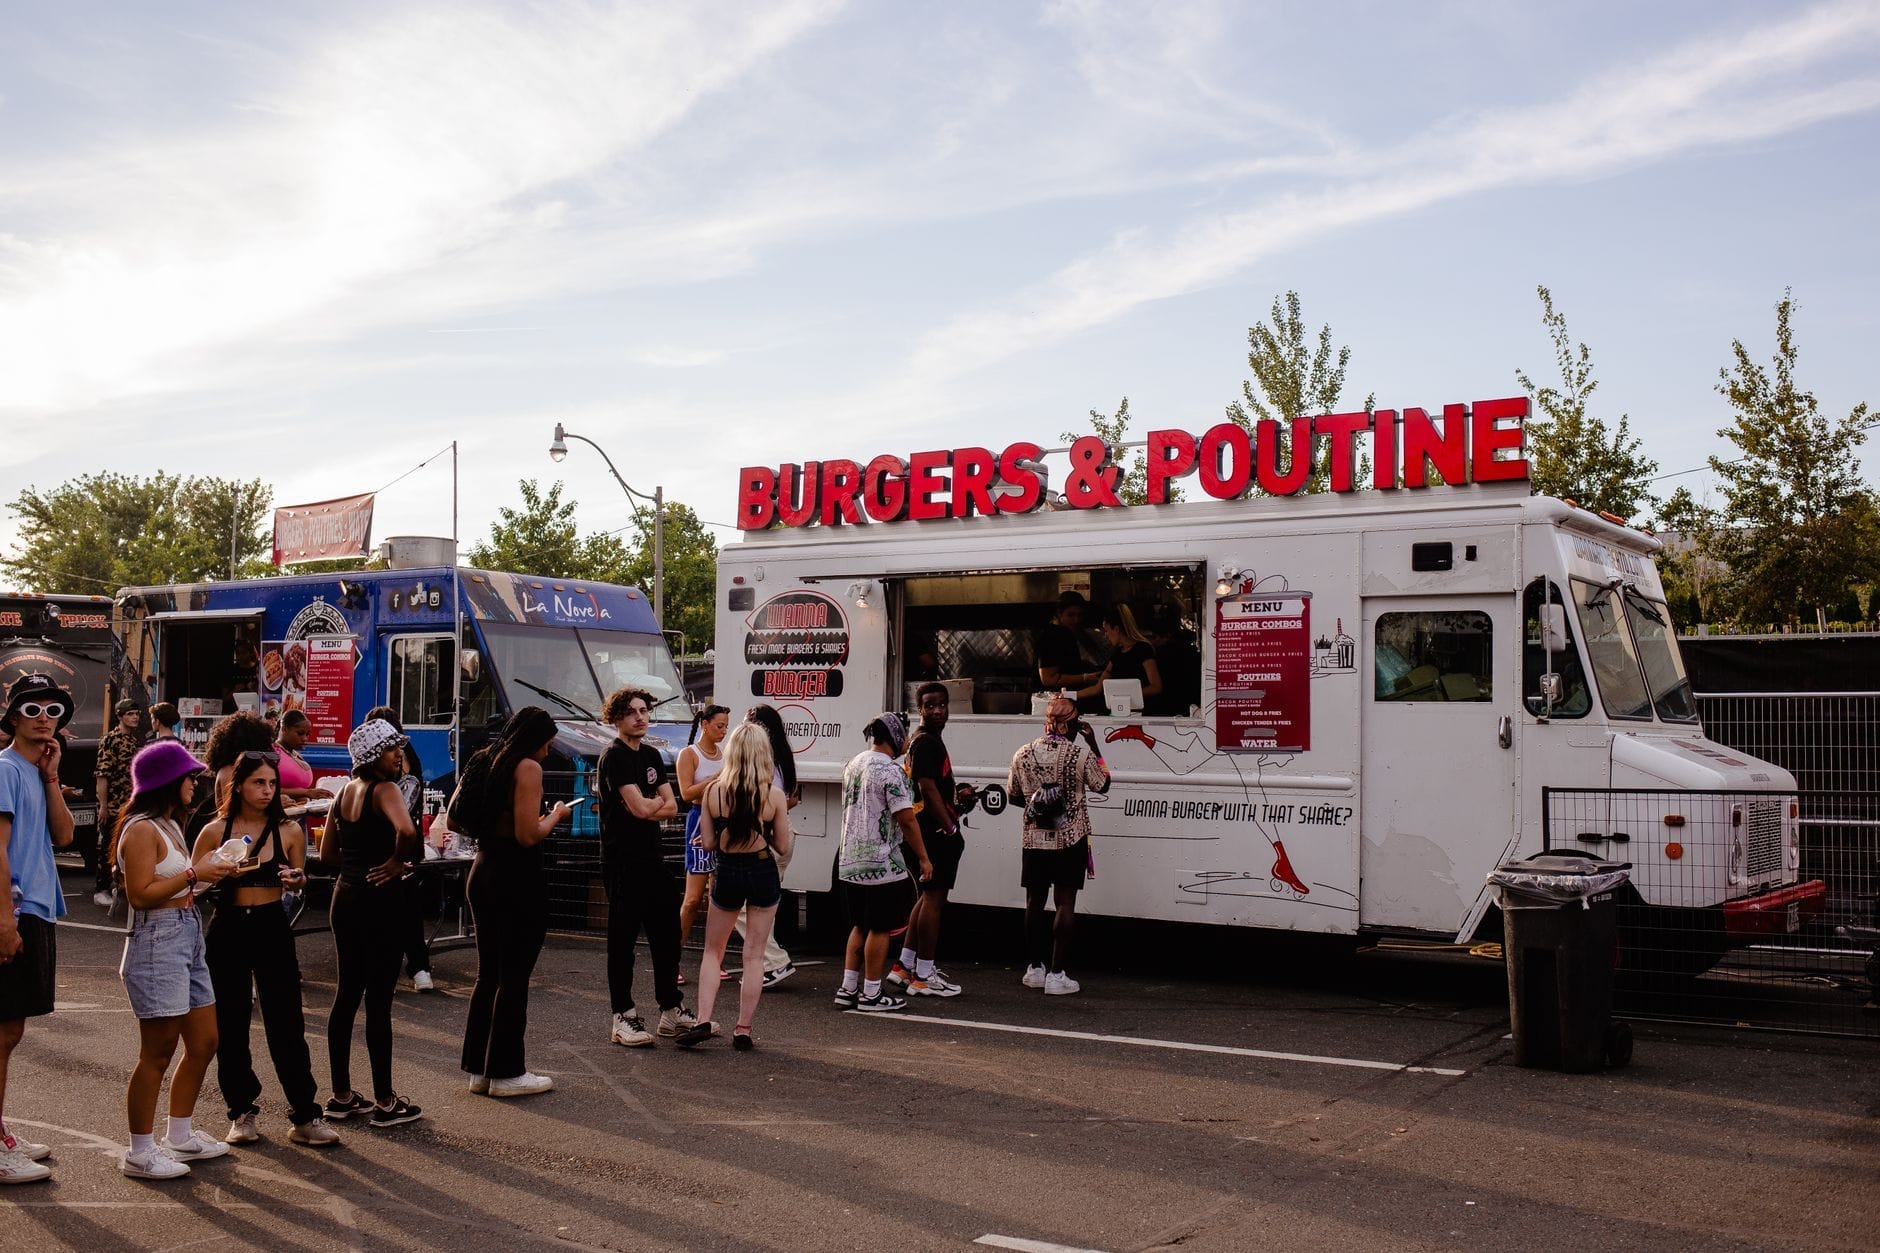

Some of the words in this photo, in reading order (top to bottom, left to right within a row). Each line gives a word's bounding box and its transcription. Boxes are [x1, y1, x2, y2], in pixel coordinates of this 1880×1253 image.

[737, 442, 1048, 530] BURGERS
[1065, 436, 1122, 508] &
[1147, 396, 1531, 505] POUTINE
[522, 591, 549, 613] La
[554, 592, 611, 623] Novela
[1241, 602, 1283, 613] MENU
[58, 614, 109, 628] TRUCK
[766, 602, 828, 628] WANNA
[1221, 621, 1259, 630] BURGER
[1261, 620, 1302, 629] COMBOS
[747, 643, 767, 655] FRESH
[768, 643, 786, 655] MADE
[786, 643, 814, 655] BURGERS
[821, 642, 846, 654] SHAKES
[764, 671, 828, 696] BURGER
[1237, 673, 1281, 681] POUTINES
[784, 722, 841, 738] URGERTO.COM
[1240, 740, 1277, 748] WATER
[1124, 798, 1168, 818] WANNA
[1171, 800, 1219, 820] BURGER
[1223, 802, 1256, 822] WITH
[1262, 804, 1295, 824] THAT
